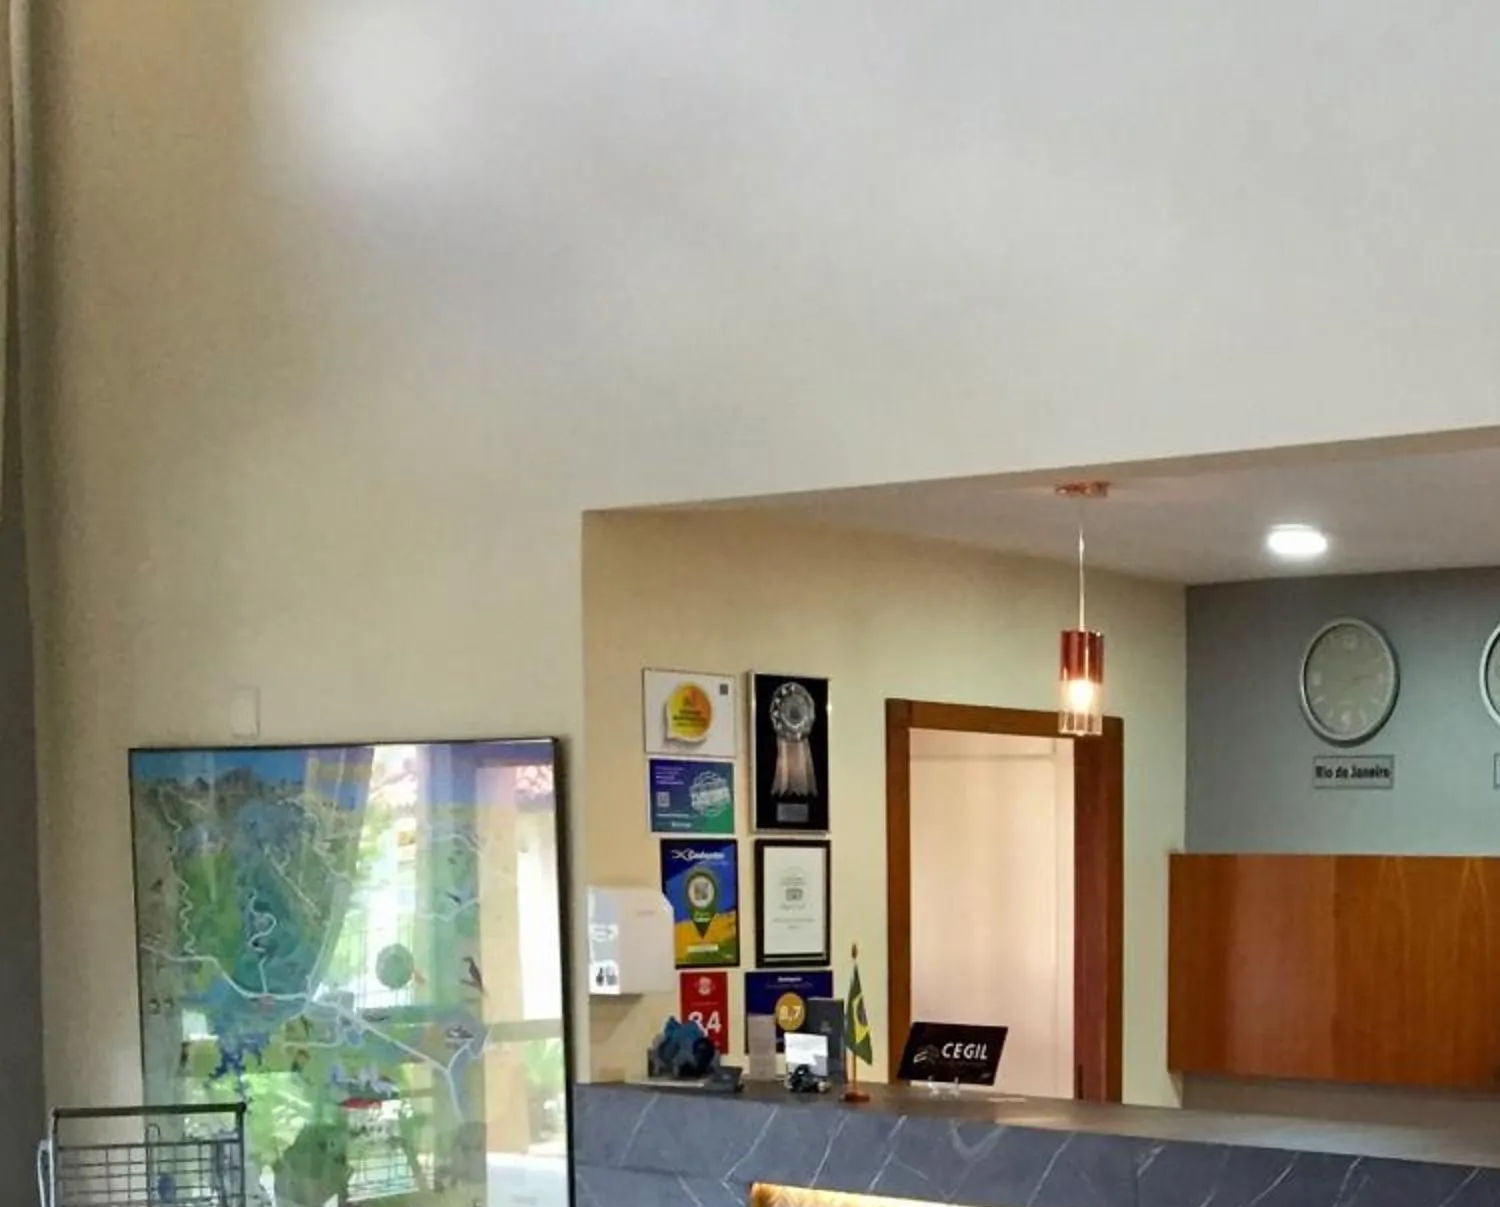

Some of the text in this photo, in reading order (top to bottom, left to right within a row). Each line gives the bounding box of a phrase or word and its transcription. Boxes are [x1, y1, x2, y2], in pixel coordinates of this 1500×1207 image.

[1314, 764, 1391, 779] Rio de Janeiro
[941, 1043, 988, 1060] CEGIL
